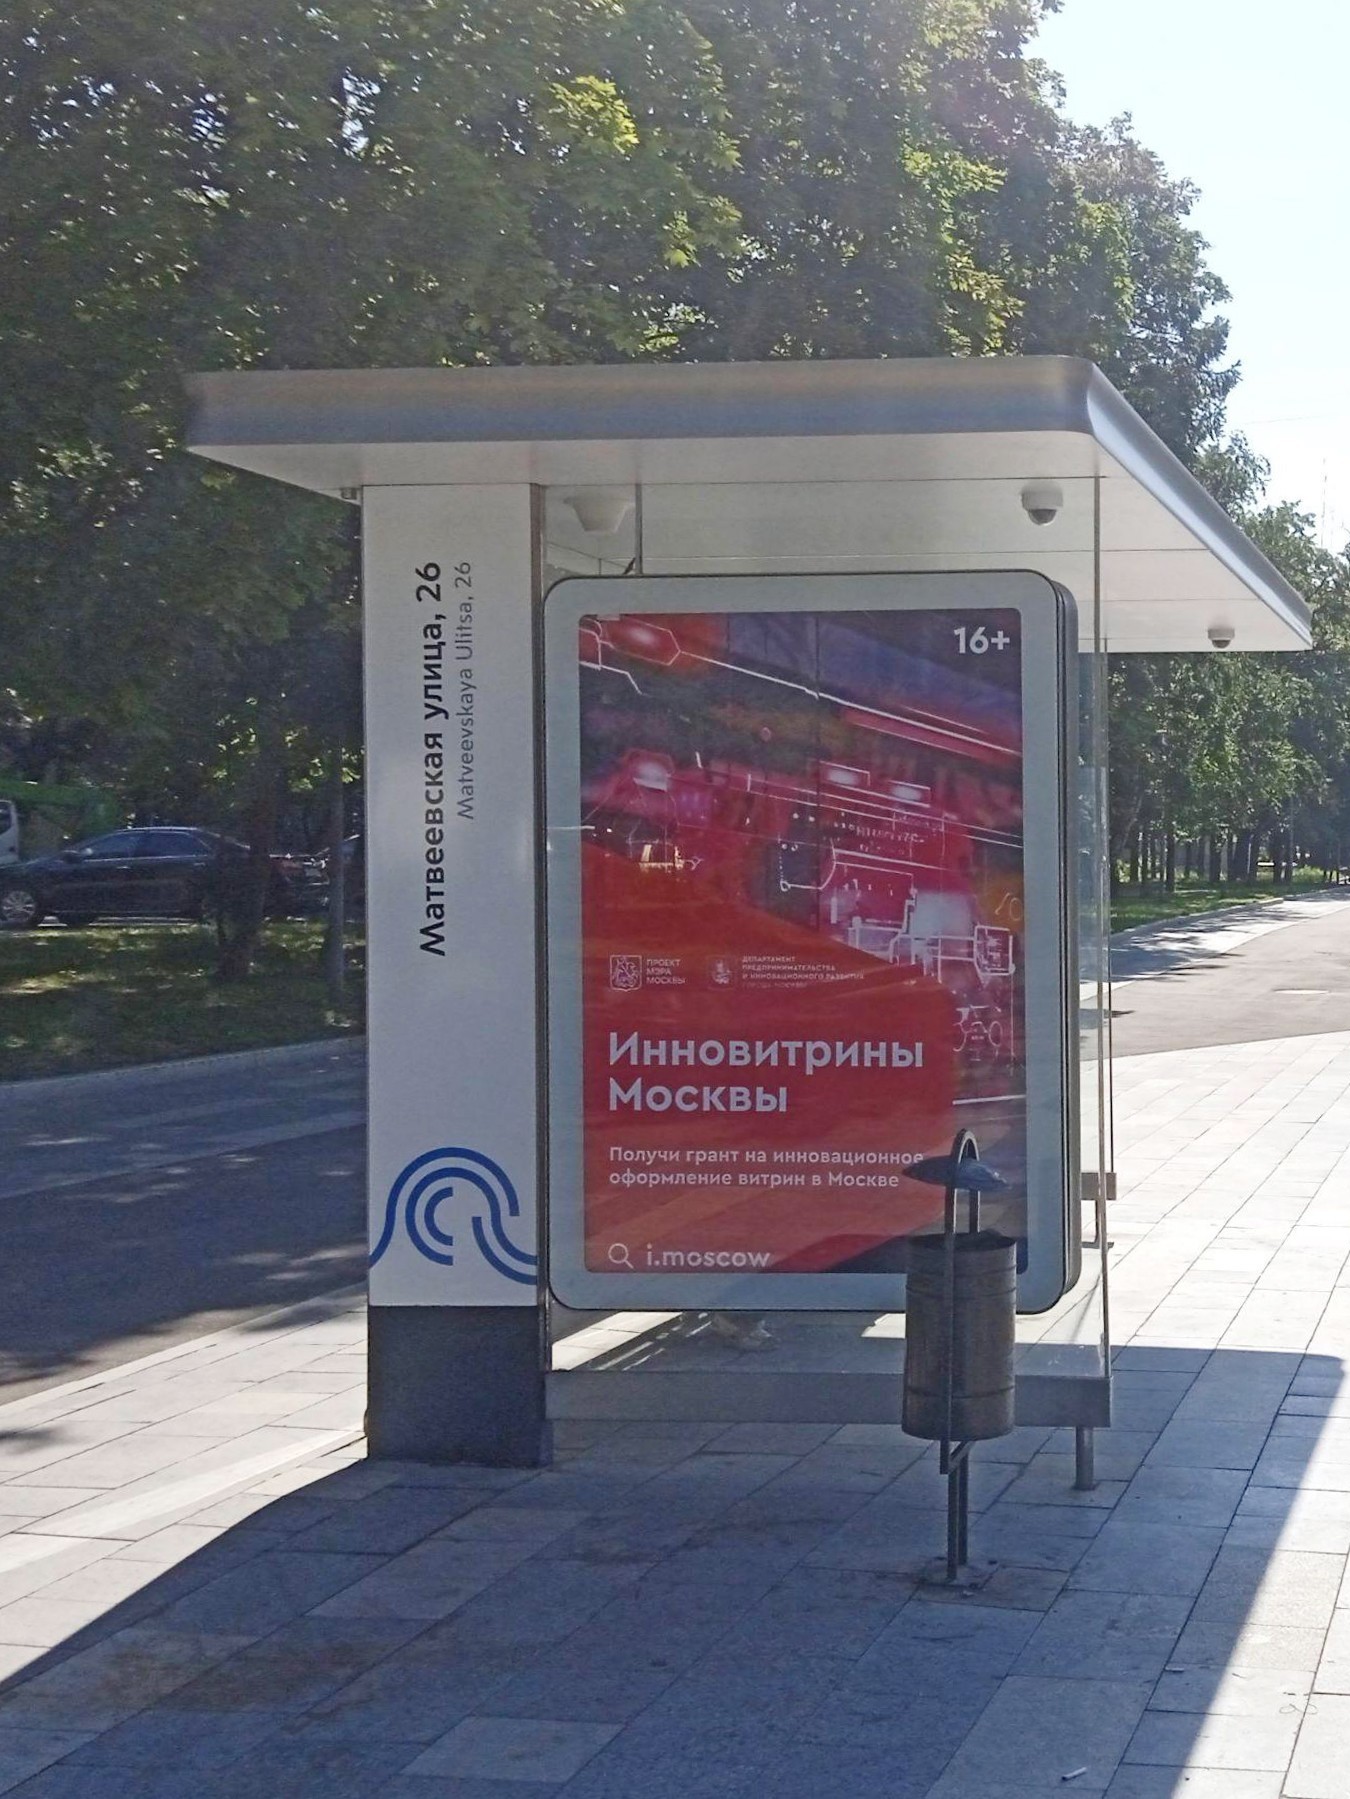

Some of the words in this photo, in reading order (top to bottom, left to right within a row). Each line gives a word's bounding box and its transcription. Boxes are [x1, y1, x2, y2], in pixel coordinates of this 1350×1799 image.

[416, 561, 442, 603] 26
[454, 561, 473, 588] 26
[454, 595, 475, 660] Ulitsa,
[953, 626, 1011, 654] 16+
[422, 613, 450, 721] улица,
[456, 668, 478, 821] Matveevskaya
[419, 731, 446, 957] Матвеевская
[646, 958, 681, 967] ПРОЕКТ
[646, 967, 672, 976] МЭРА
[645, 976, 686, 985] МОСКВЫ
[609, 1031, 923, 1076] Инновитрины
[609, 1077, 788, 1112] Москвы
[609, 1146, 680, 1165] Получи
[686, 1150, 739, 1165] грант
[745, 1151, 767, 1163] на
[773, 1151, 924, 1166] инновационное
[609, 1167, 732, 1188] оформление
[738, 1173, 806, 1189] витрин
[812, 1174, 822, 1186] в
[828, 1171, 899, 1187] Москве
[646, 1242, 771, 1268] i.moscow
